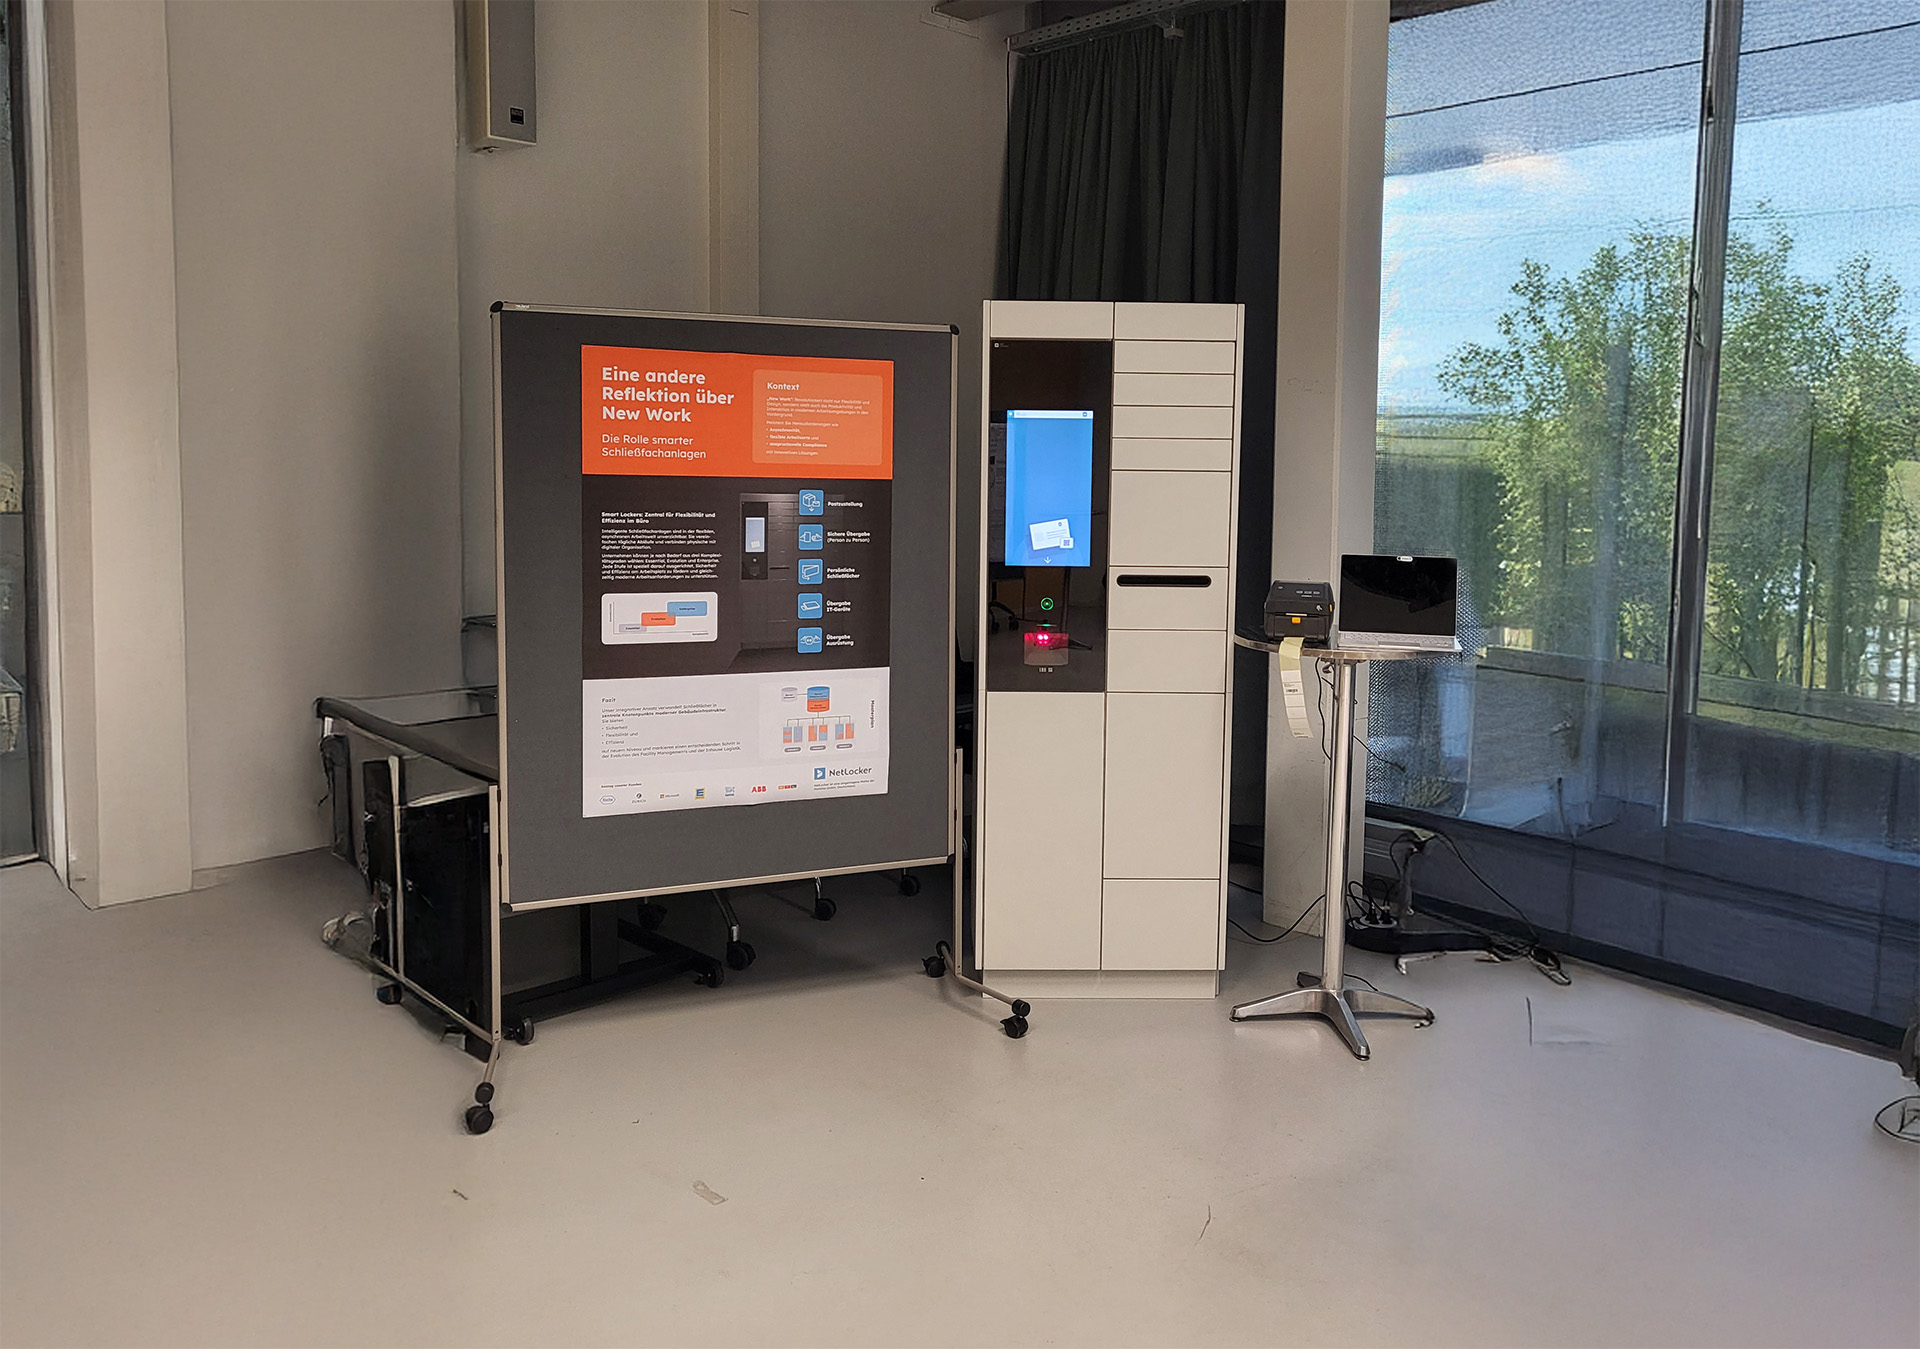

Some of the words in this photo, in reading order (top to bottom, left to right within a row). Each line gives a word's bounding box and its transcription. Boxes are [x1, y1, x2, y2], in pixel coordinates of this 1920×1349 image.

[602, 366, 640, 382] Eine
[645, 370, 706, 384] andere
[767, 382, 800, 391] Kontext
[602, 386, 690, 402] Reflektion
[696, 389, 734, 404] über
[602, 406, 640, 420] New
[646, 408, 692, 422] Work
[602, 434, 620, 444] Die
[624, 434, 649, 444] Rolle
[652, 436, 693, 445] smarter
[602, 448, 706, 460] Schließfachanlagen
[846, 530, 870, 538] Übergabe
[829, 766, 872, 776] NetLocker
